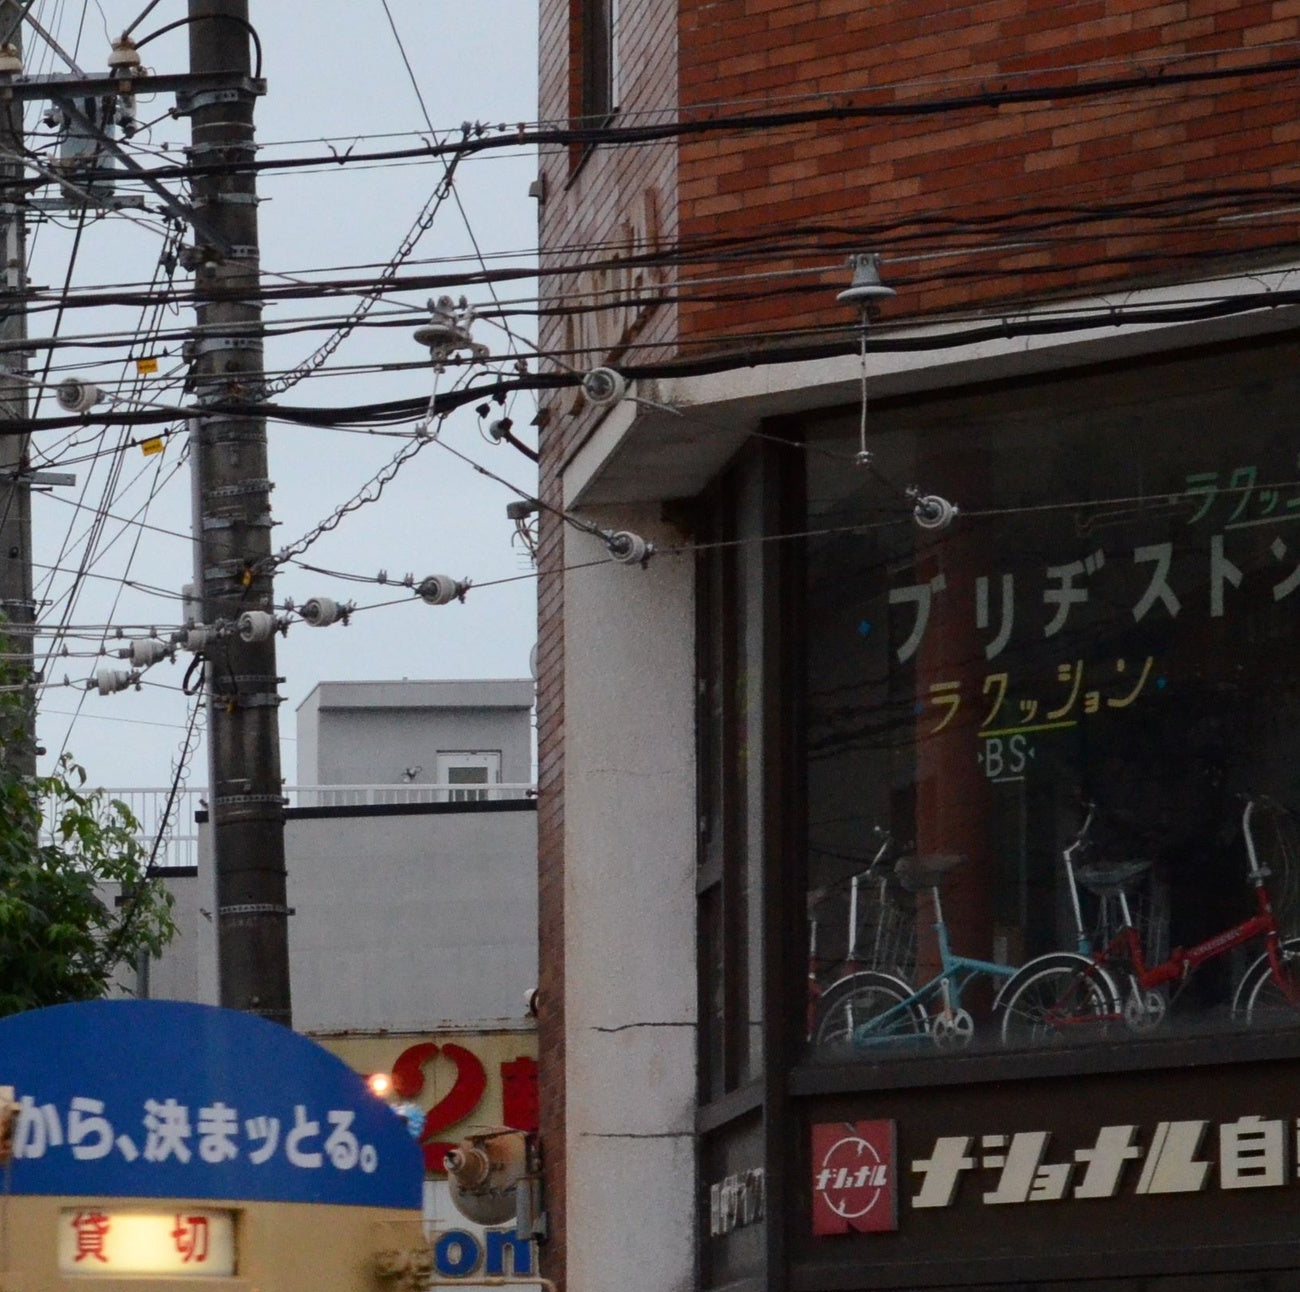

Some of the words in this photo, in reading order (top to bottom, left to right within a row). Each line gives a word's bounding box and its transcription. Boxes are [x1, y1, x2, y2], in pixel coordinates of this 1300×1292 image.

[1186, 464, 1300, 525] ラクッ
[928, 656, 1153, 735] ラクッション
[985, 734, 1027, 778] BS
[815, 1164, 888, 1191] ナショナル
[911, 1114, 1300, 1209] ナショナル自
